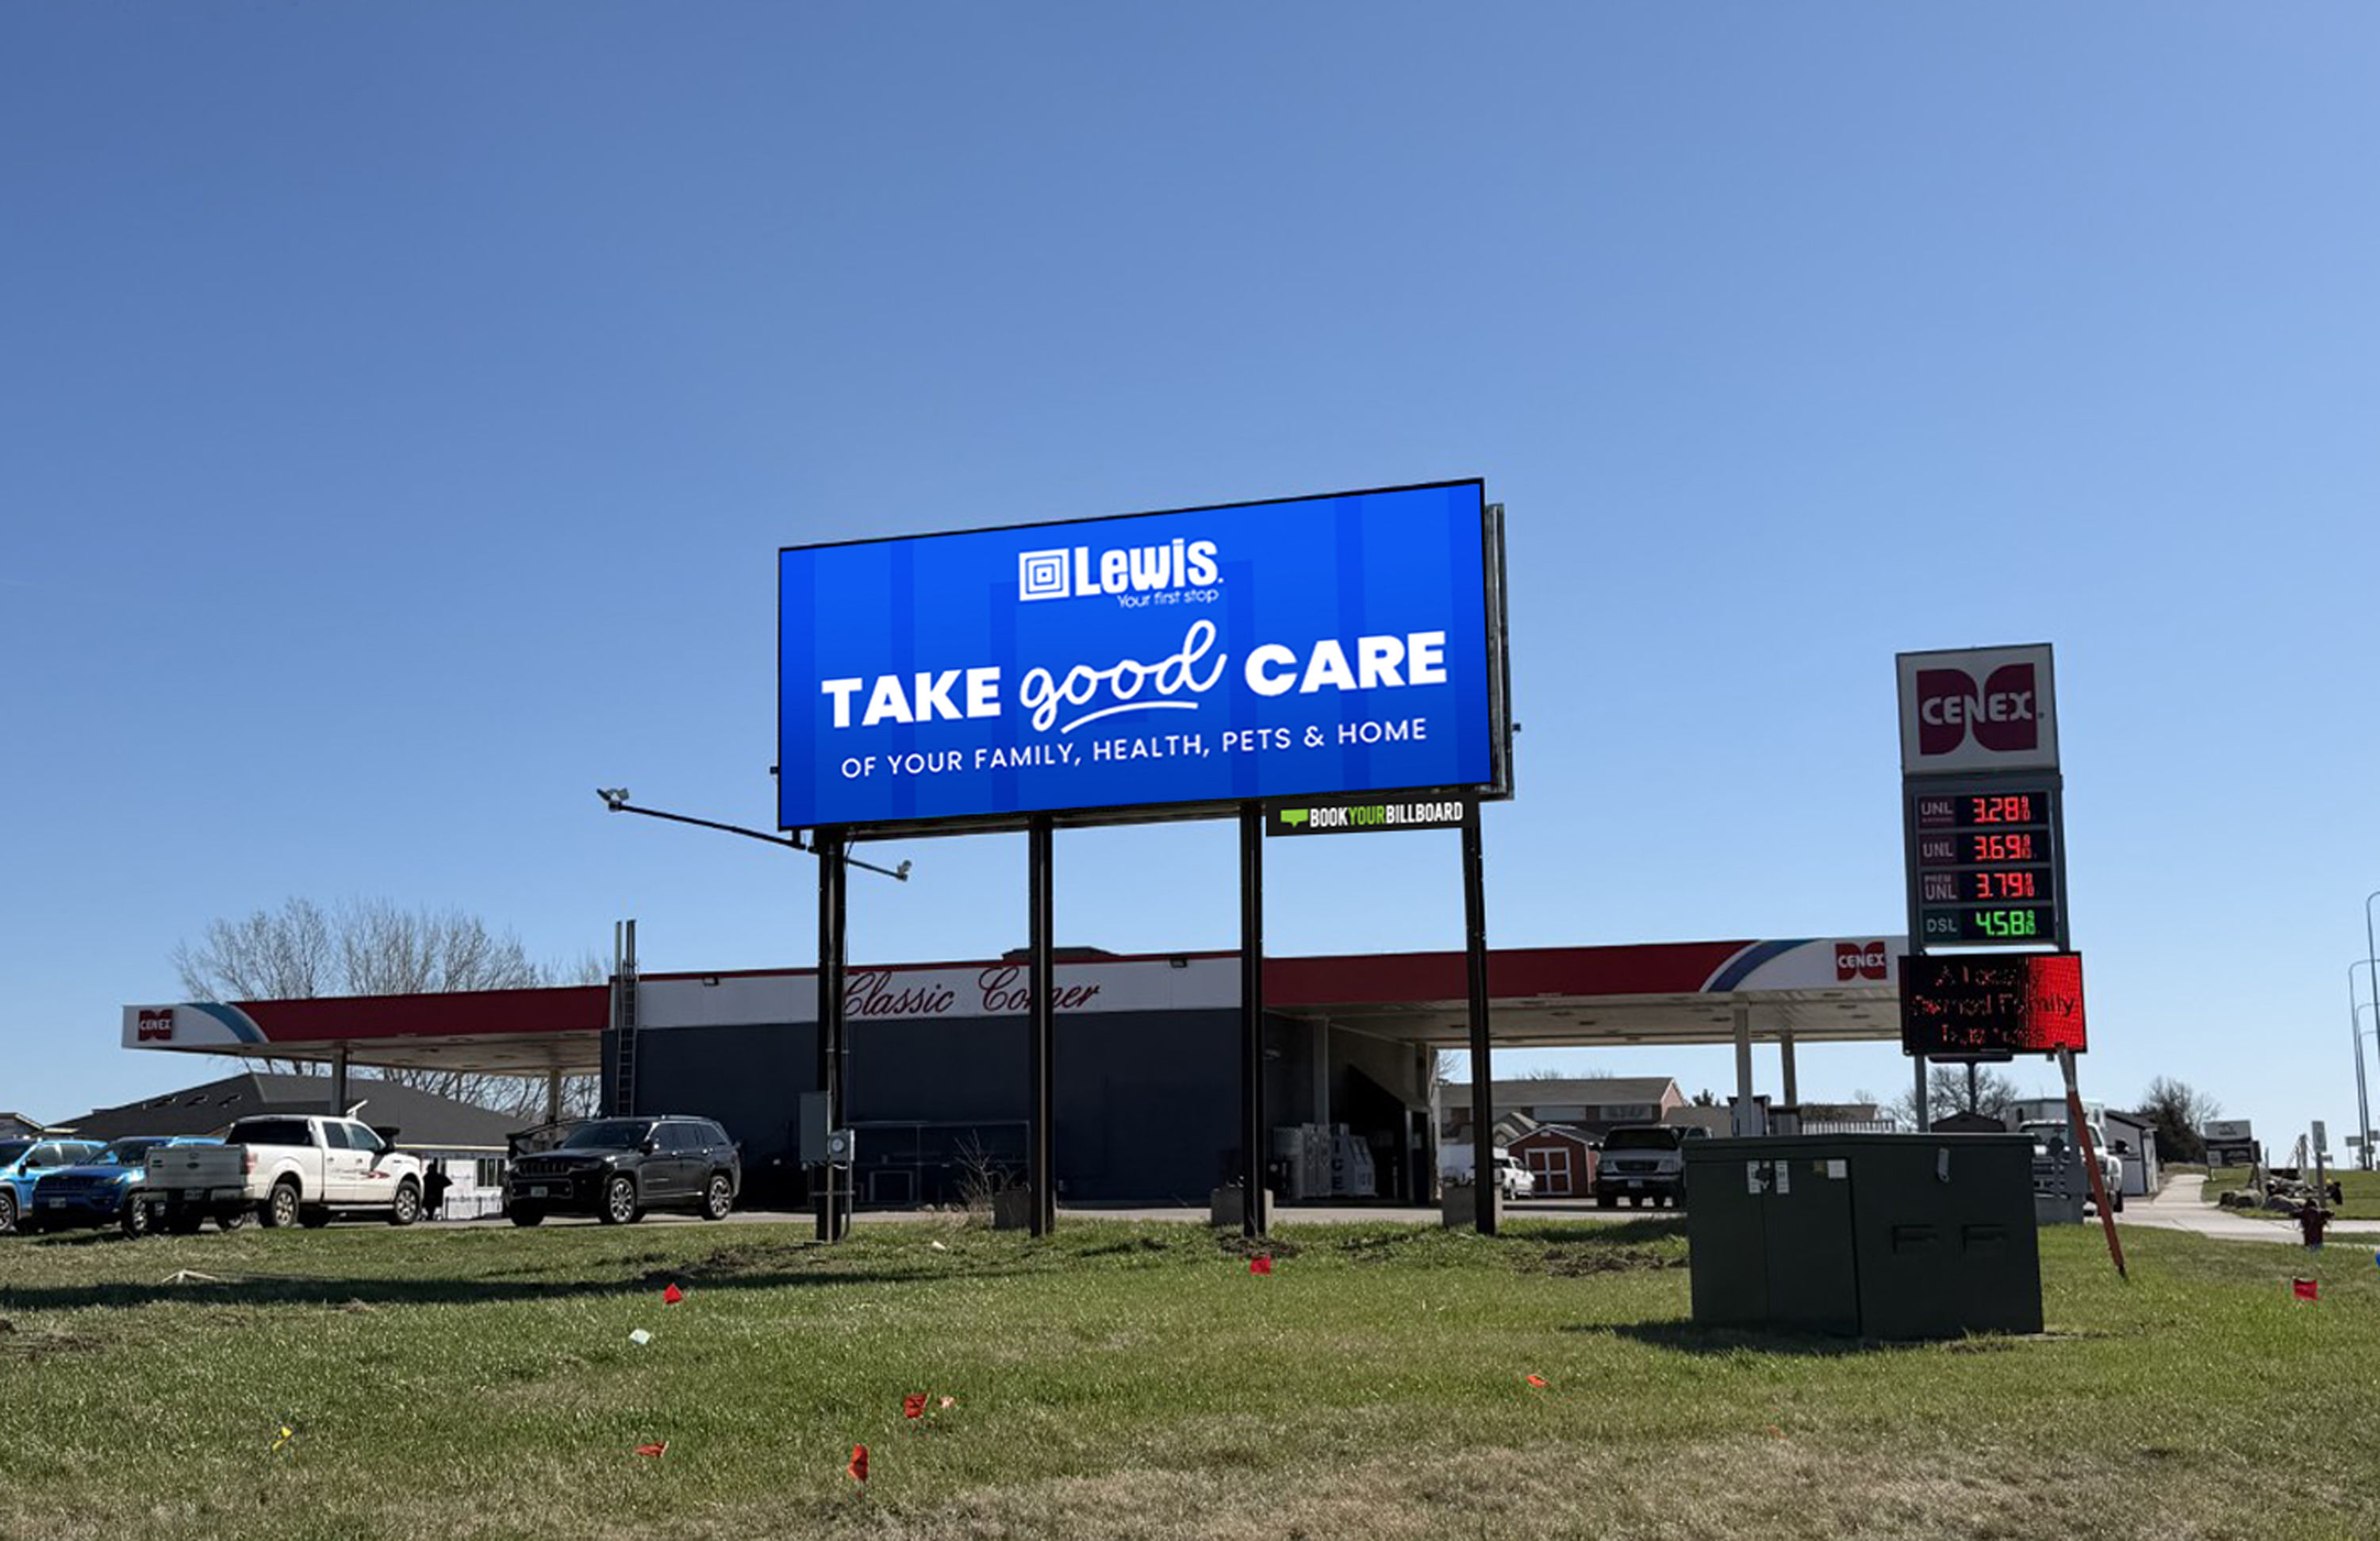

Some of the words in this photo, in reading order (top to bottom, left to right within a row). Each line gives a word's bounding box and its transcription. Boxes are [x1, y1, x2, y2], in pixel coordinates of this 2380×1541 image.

[1117, 594, 1150, 608] Your
[1154, 590, 1180, 605] first
[1184, 589, 1219, 604] stop
[821, 667, 1002, 728] TAKE
[1020, 620, 1227, 732] good
[1245, 631, 1448, 697] CARE
[1921, 690, 2033, 726] CENEX
[842, 757, 876, 778] OF
[889, 751, 962, 775] YOUR
[975, 743, 1081, 769] FAMILY,
[1093, 735, 1209, 762] HEALTH,
[1223, 728, 1291, 752] PETS
[1303, 725, 1324, 747] &
[1338, 718, 1426, 744] HOME
[1921, 801, 1954, 816] UNL
[1922, 841, 1954, 858] UNL
[1925, 883, 1957, 901] UNL
[1925, 917, 1958, 933] DSL
[1838, 953, 1886, 968] CENEX
[843, 970, 955, 1017] Classic
[978, 966, 1100, 1012] Coner
[140, 1019, 172, 1031] CENEX
